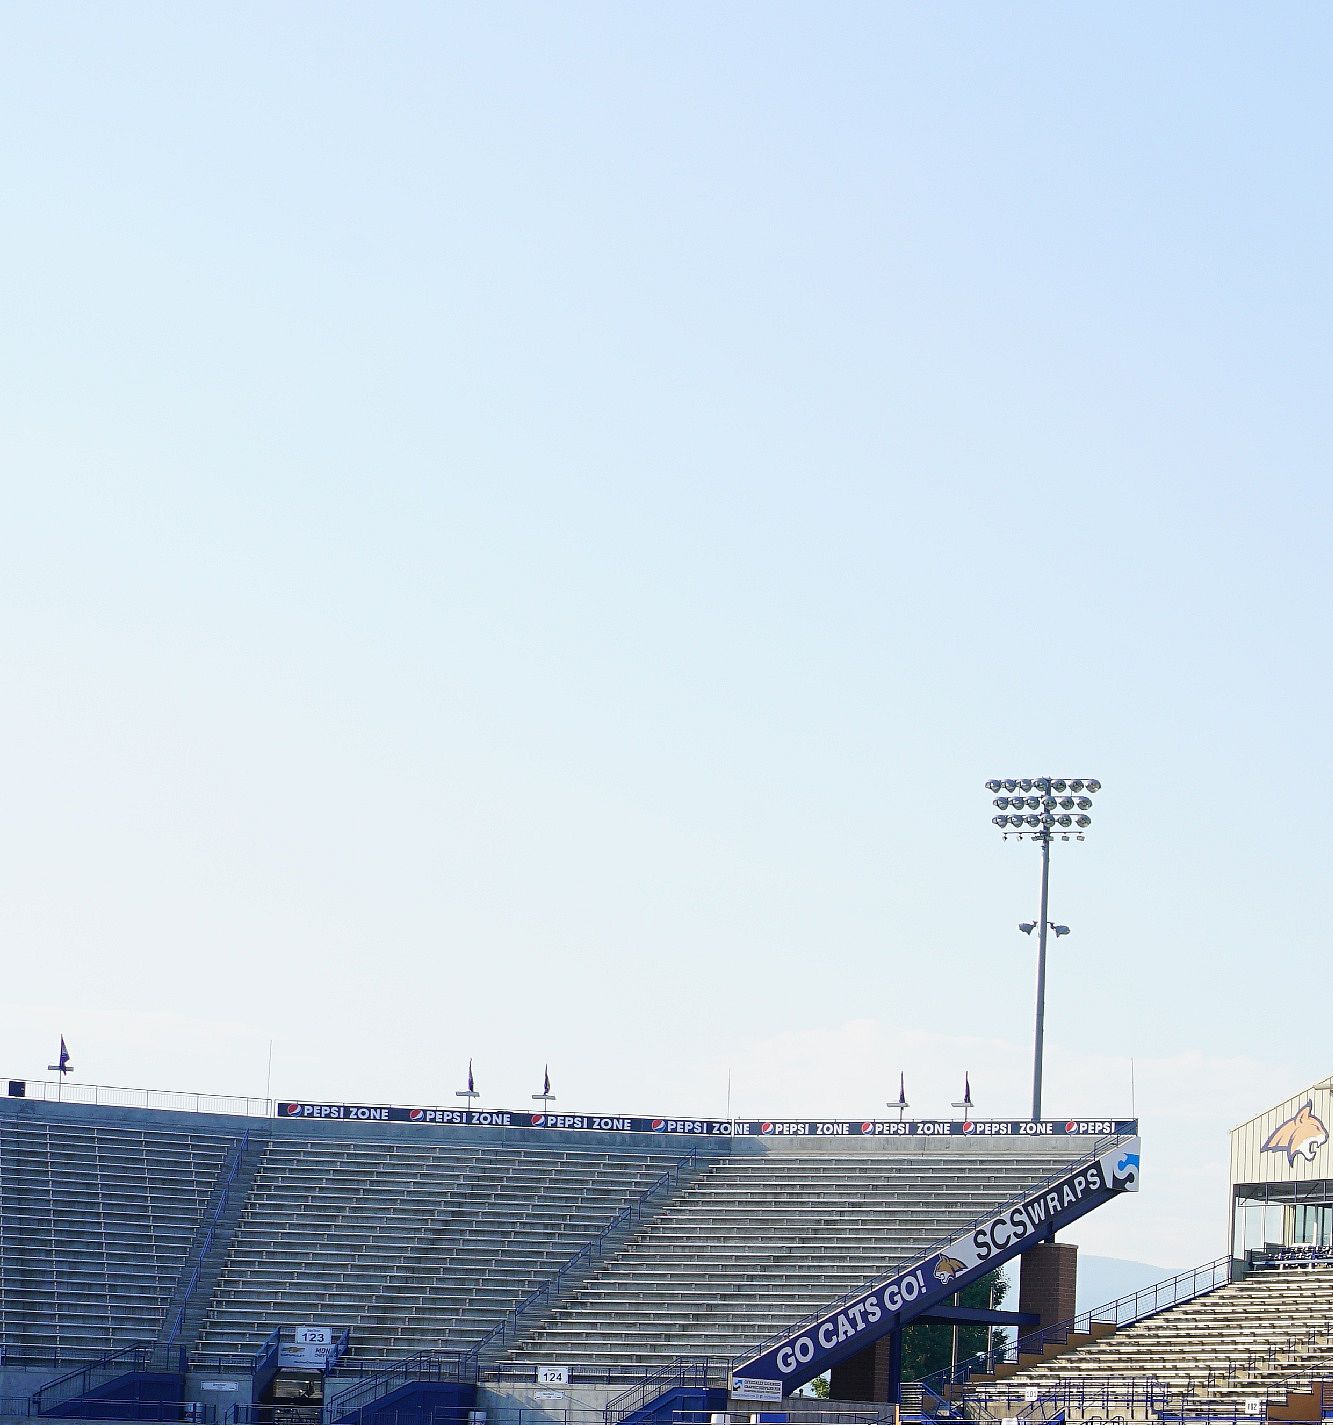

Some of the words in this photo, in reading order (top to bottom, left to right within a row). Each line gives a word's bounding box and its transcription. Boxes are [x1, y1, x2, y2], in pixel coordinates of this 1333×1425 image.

[304, 1106, 344, 1118] PEPSI
[349, 1107, 389, 1120] ZONE
[426, 1111, 466, 1123] PEPSI
[472, 1112, 511, 1125] ZONE
[547, 1116, 587, 1128] PEPSI
[592, 1118, 631, 1130] ZONE
[667, 1121, 707, 1133] PEPSI
[712, 1122, 750, 1135] ZONE
[775, 1123, 809, 1135] PEPSI
[816, 1122, 850, 1135] ZONE
[875, 1123, 909, 1135] PEPSI
[916, 1123, 951, 1135] ZONE
[976, 1123, 1012, 1135] PEPSI
[1019, 1123, 1053, 1135] ZONE
[1080, 1122, 1115, 1134] PEPSI
[776, 1336, 814, 1373] GO
[818, 1296, 881, 1349] CATS
[883, 1270, 927, 1311] GO!
[302, 1333, 324, 1342] 123
[543, 1372, 563, 1382] 124
